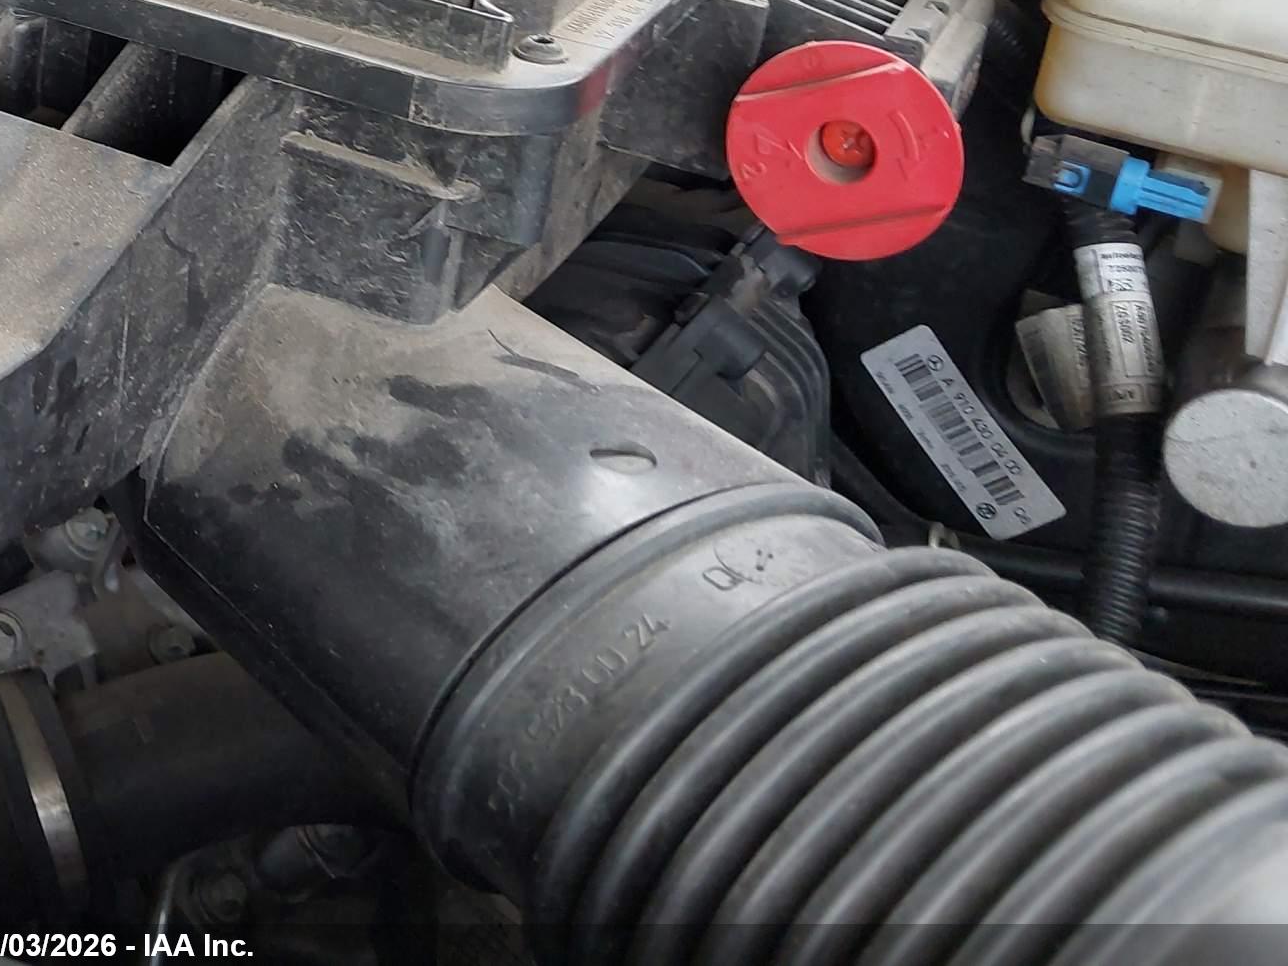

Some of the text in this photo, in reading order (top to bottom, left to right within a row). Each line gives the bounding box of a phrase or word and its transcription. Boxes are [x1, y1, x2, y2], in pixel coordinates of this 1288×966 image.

[941, 377, 1023, 477] A 910 430 04 00
